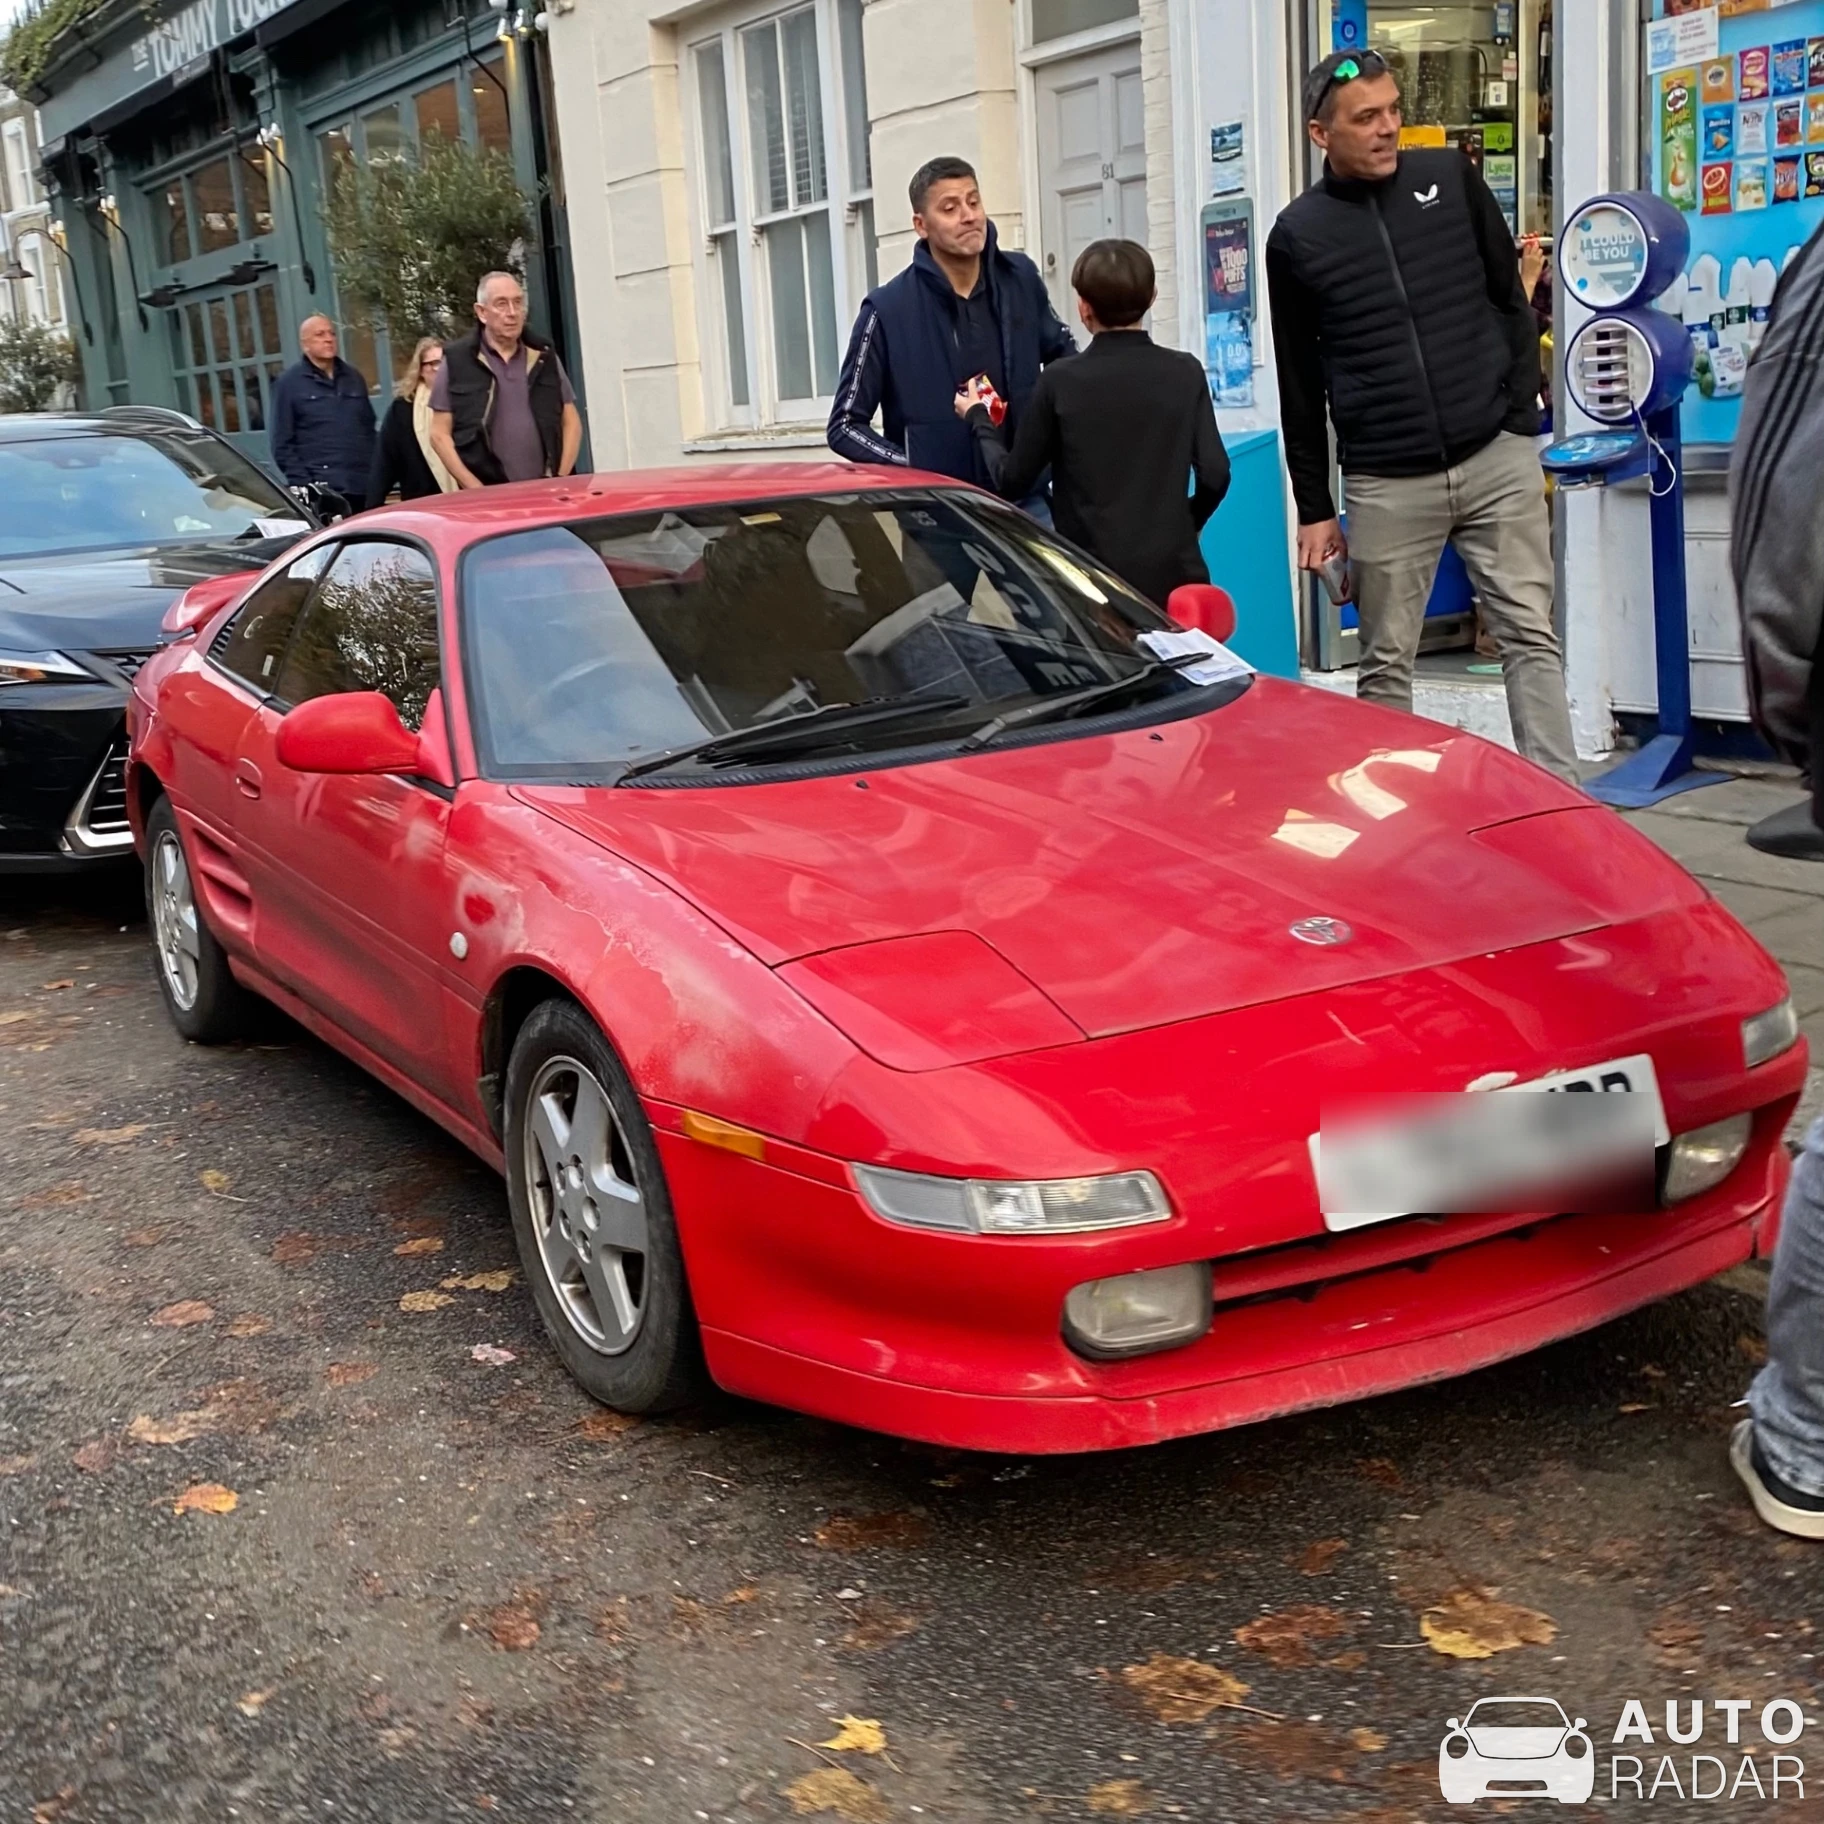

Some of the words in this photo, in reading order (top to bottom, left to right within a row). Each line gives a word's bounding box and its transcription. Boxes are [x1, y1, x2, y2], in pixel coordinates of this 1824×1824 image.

[147, 0, 219, 78] TOMMY
[1101, 162, 1114, 180] 81
[1488, 161, 1512, 175] Lyca
[1591, 232, 1635, 247] COULD
[1226, 248, 1248, 268] 1000
[1584, 247, 1600, 260] BE
[1601, 245, 1629, 260] YOU
